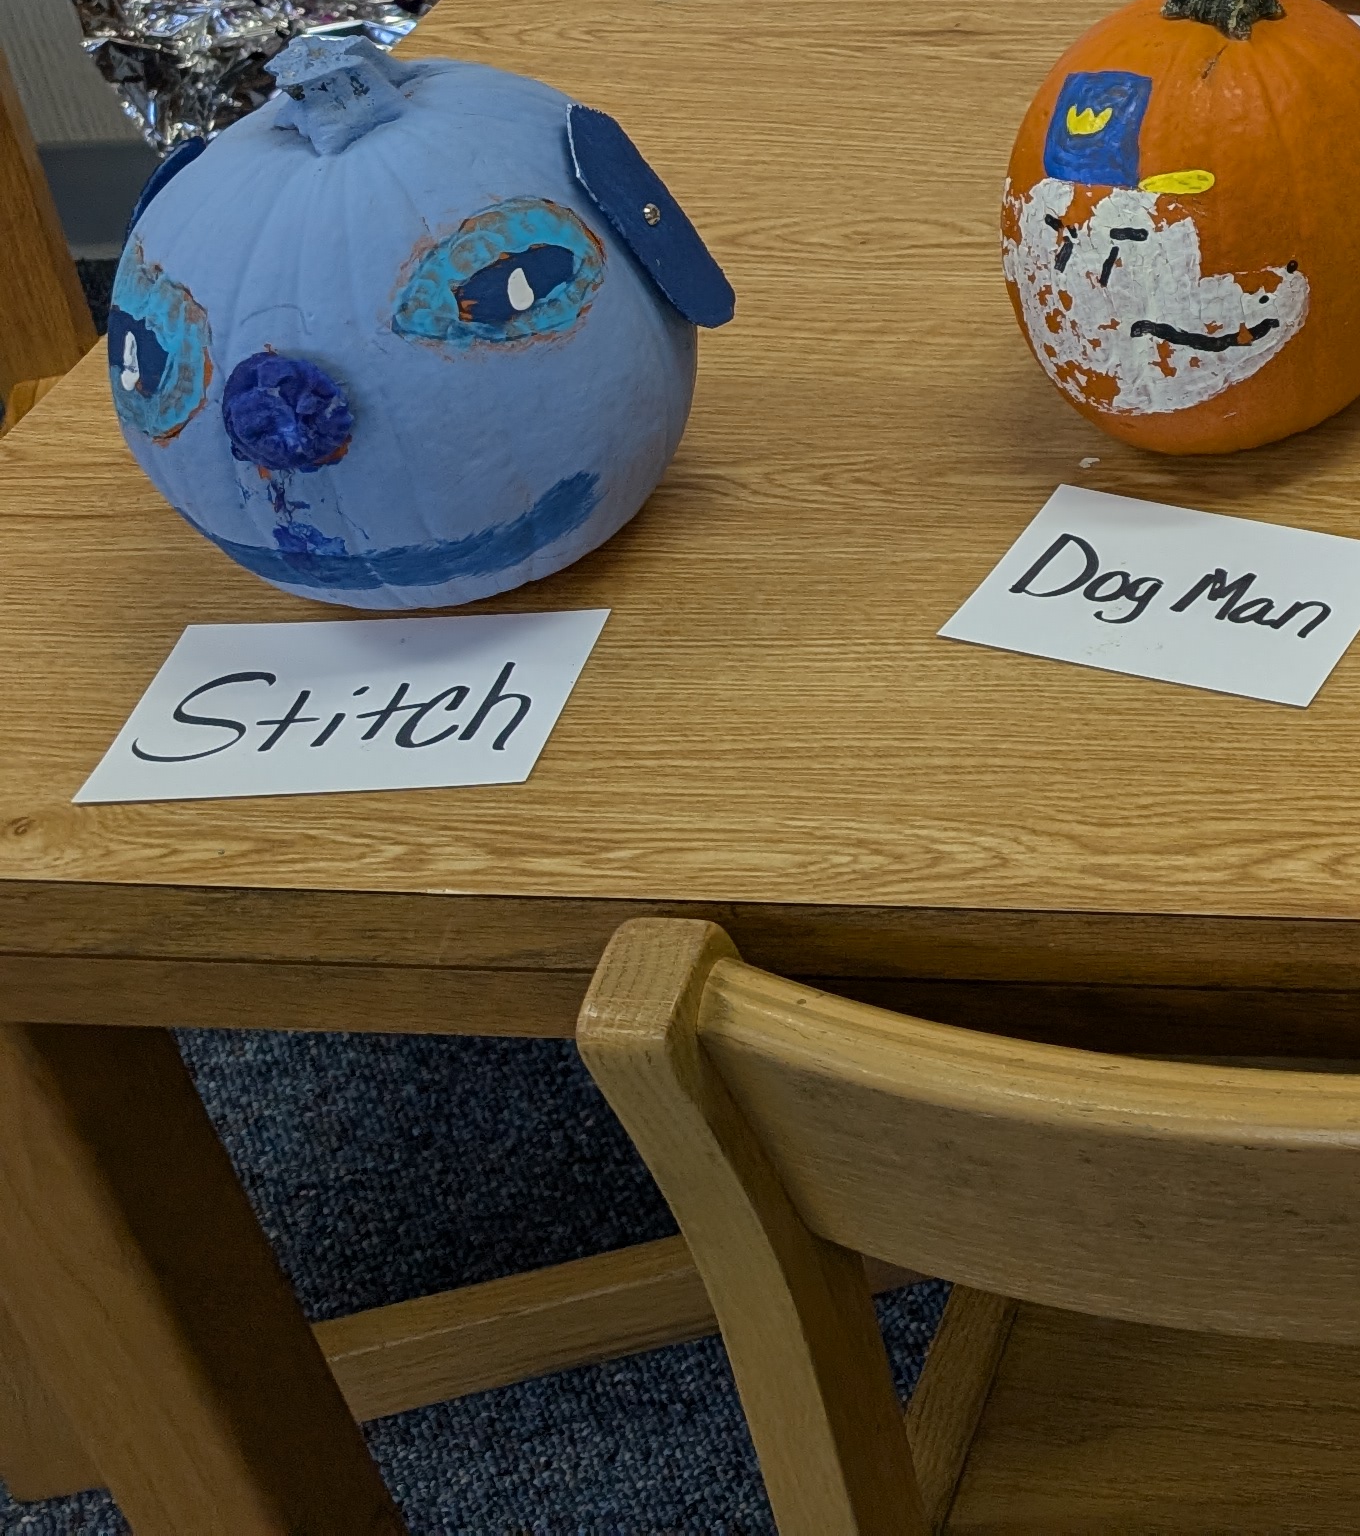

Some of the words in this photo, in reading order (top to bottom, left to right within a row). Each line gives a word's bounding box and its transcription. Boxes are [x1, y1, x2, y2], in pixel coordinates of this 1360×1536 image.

[1008, 532, 1164, 624] Dog
[1169, 567, 1332, 639] Man
[131, 661, 532, 763] Stitch
